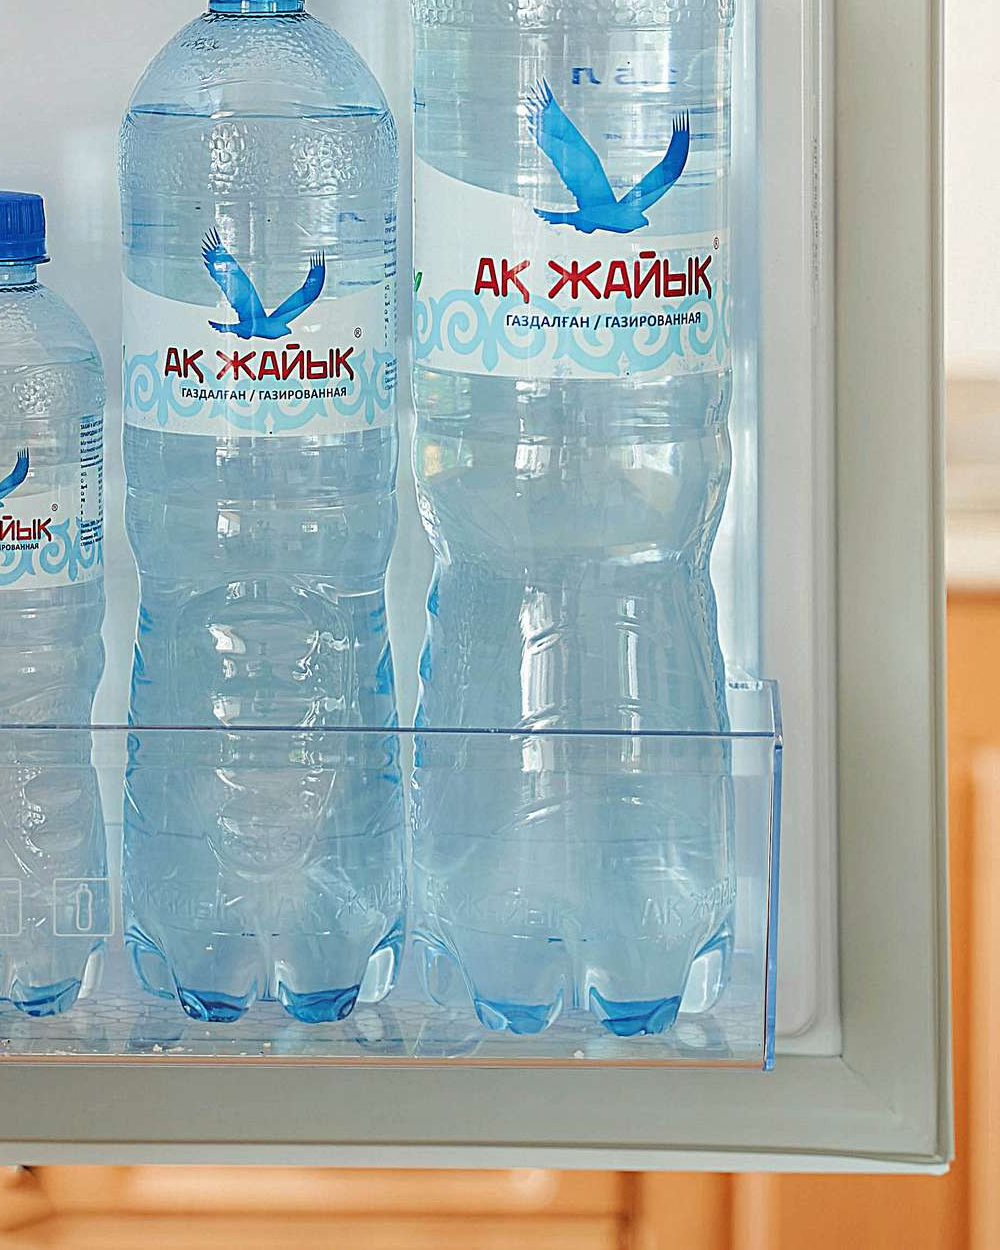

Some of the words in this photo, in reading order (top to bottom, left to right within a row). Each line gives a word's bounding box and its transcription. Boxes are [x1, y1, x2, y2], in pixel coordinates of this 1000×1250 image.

[474, 257, 531, 303] АҚ
[548, 250, 712, 300] ЖАЙЫҚ
[506, 315, 590, 329] ГАЗДАЛҒАН
[605, 311, 701, 327] ГАЗИРОВАННАЯ
[165, 347, 204, 383] АҚ
[216, 343, 354, 381] ЖАЙЫҚ
[181, 387, 246, 401] ГАЗДАЛҒАН
[259, 386, 347, 400] ГАЗИРОВАННАЯ
